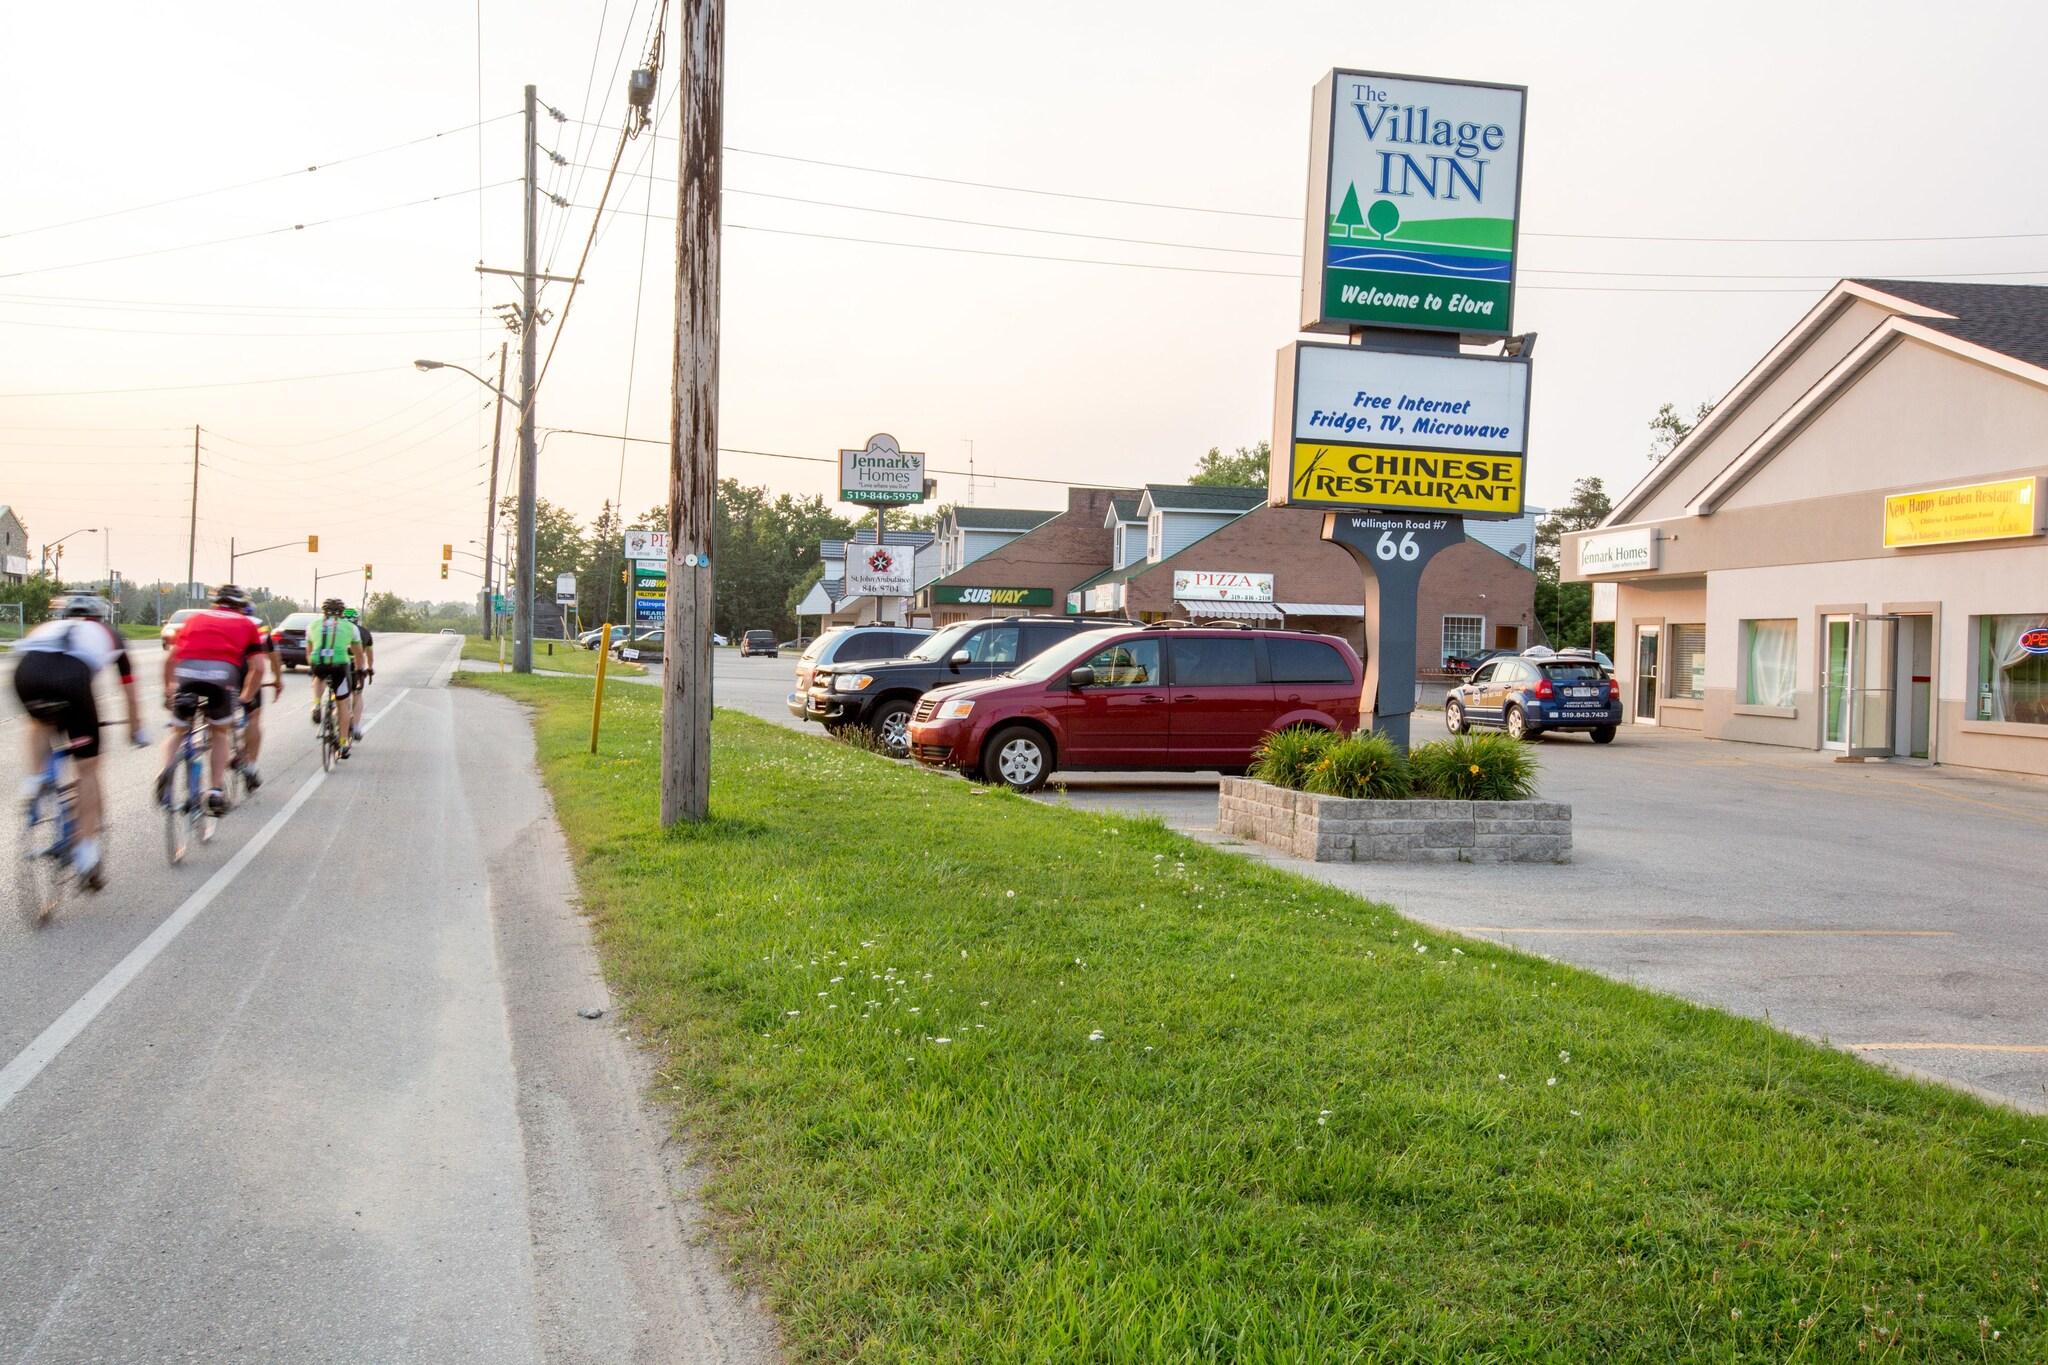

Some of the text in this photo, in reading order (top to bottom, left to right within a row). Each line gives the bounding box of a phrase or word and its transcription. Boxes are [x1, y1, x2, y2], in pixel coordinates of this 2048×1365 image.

[1352, 84, 1387, 102] The
[1351, 102, 1504, 158] Village
[1374, 150, 1490, 204] INN
[1341, 285, 1494, 316] Welcome to Elora
[1353, 392, 1472, 414] Free Internet
[1310, 410, 1510, 438] Fridge, TV, Microwave
[851, 454, 910, 469] Jennark
[1348, 454, 1513, 482] CHINESE
[860, 468, 910, 482] Homes
[846, 491, 918, 500] 519-846-5959
[1316, 474, 1516, 504] RESTAURANT
[1908, 498, 1935, 513] Happy
[1939, 492, 1972, 506] Garden
[1352, 518, 1447, 530] Wellington Road #7
[1376, 531, 1420, 561] 66
[1616, 547, 1648, 560] Homes
[638, 578, 668, 587] SUBWA
[1195, 573, 1252, 587] PIZZA
[959, 588, 1029, 604] SUBWAY
[2022, 633, 2048, 646] OPE
